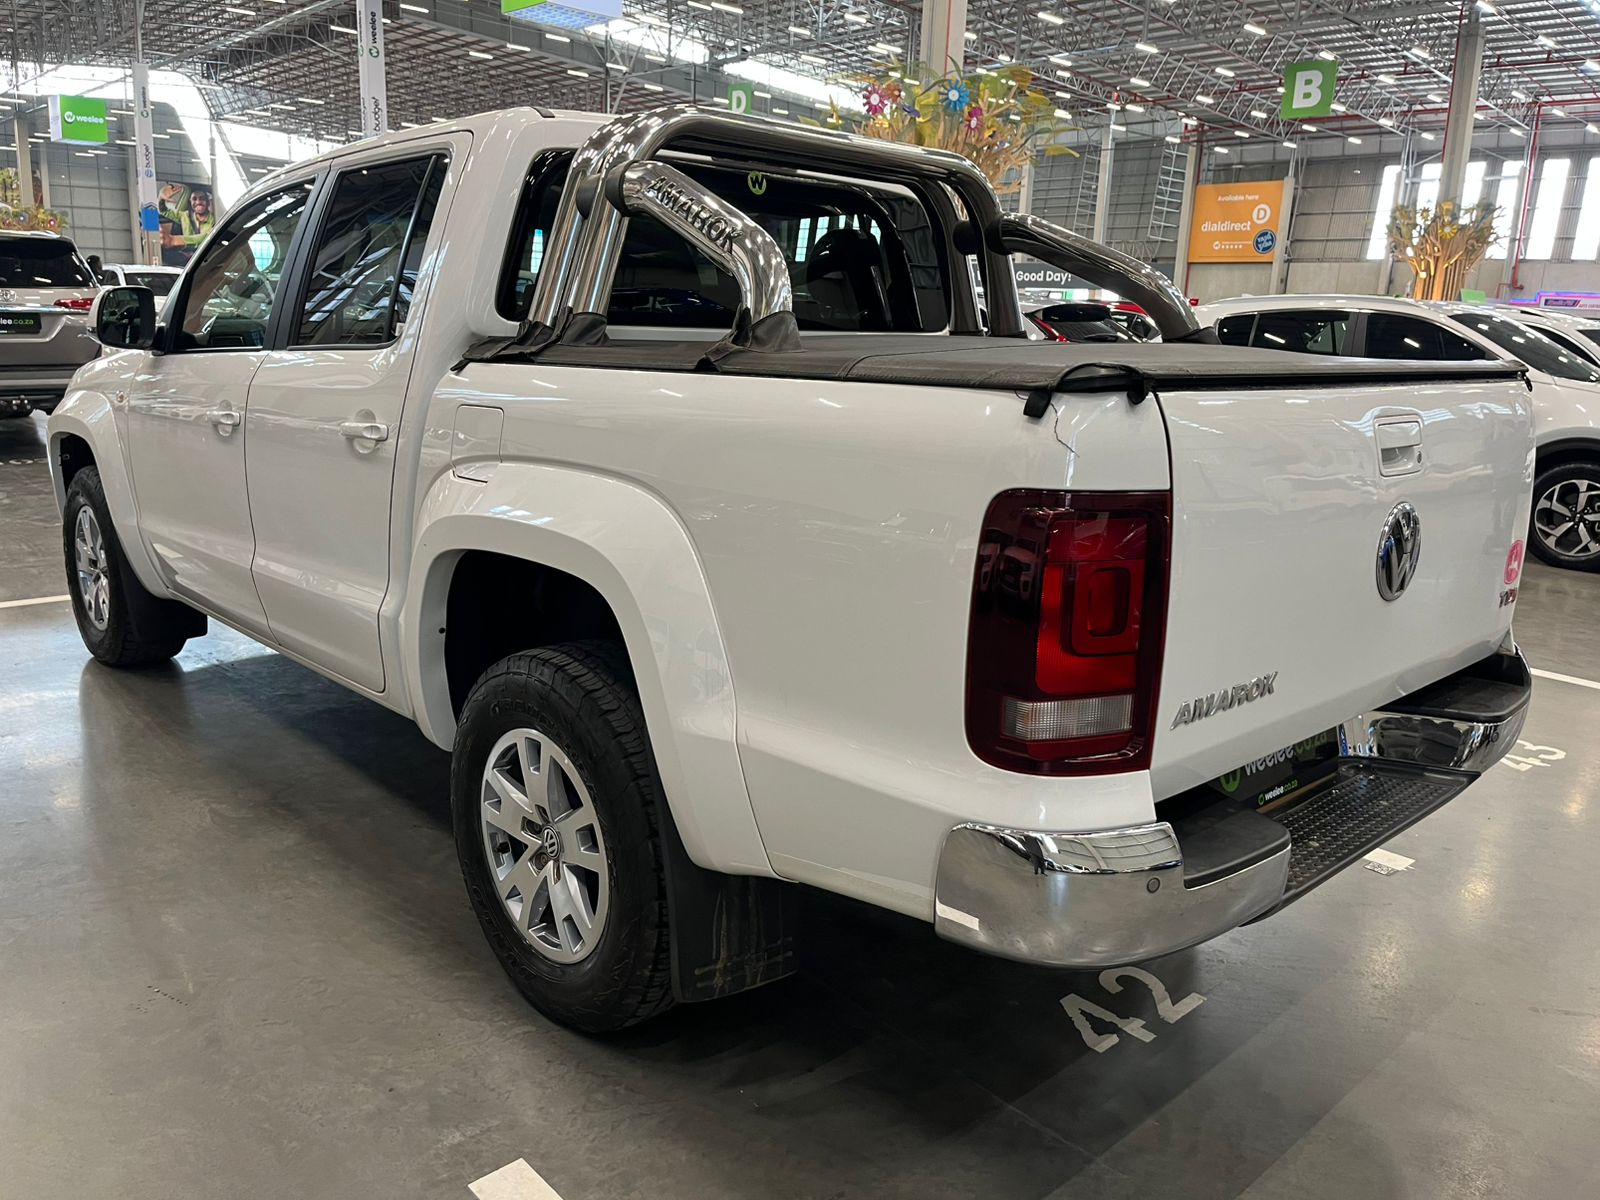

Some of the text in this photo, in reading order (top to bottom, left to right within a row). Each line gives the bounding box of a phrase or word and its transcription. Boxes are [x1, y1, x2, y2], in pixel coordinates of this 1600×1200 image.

[732, 90, 747, 113] D
[1292, 70, 1323, 109] B
[76, 115, 104, 124] weelee
[645, 175, 742, 254] AMAROK
[1201, 220, 1251, 232] dialdirect
[1016, 270, 1072, 285] Good Day!
[1170, 671, 1278, 731] AMAROK
[1500, 739, 1567, 772] 43
[1059, 966, 1208, 1053] 42
